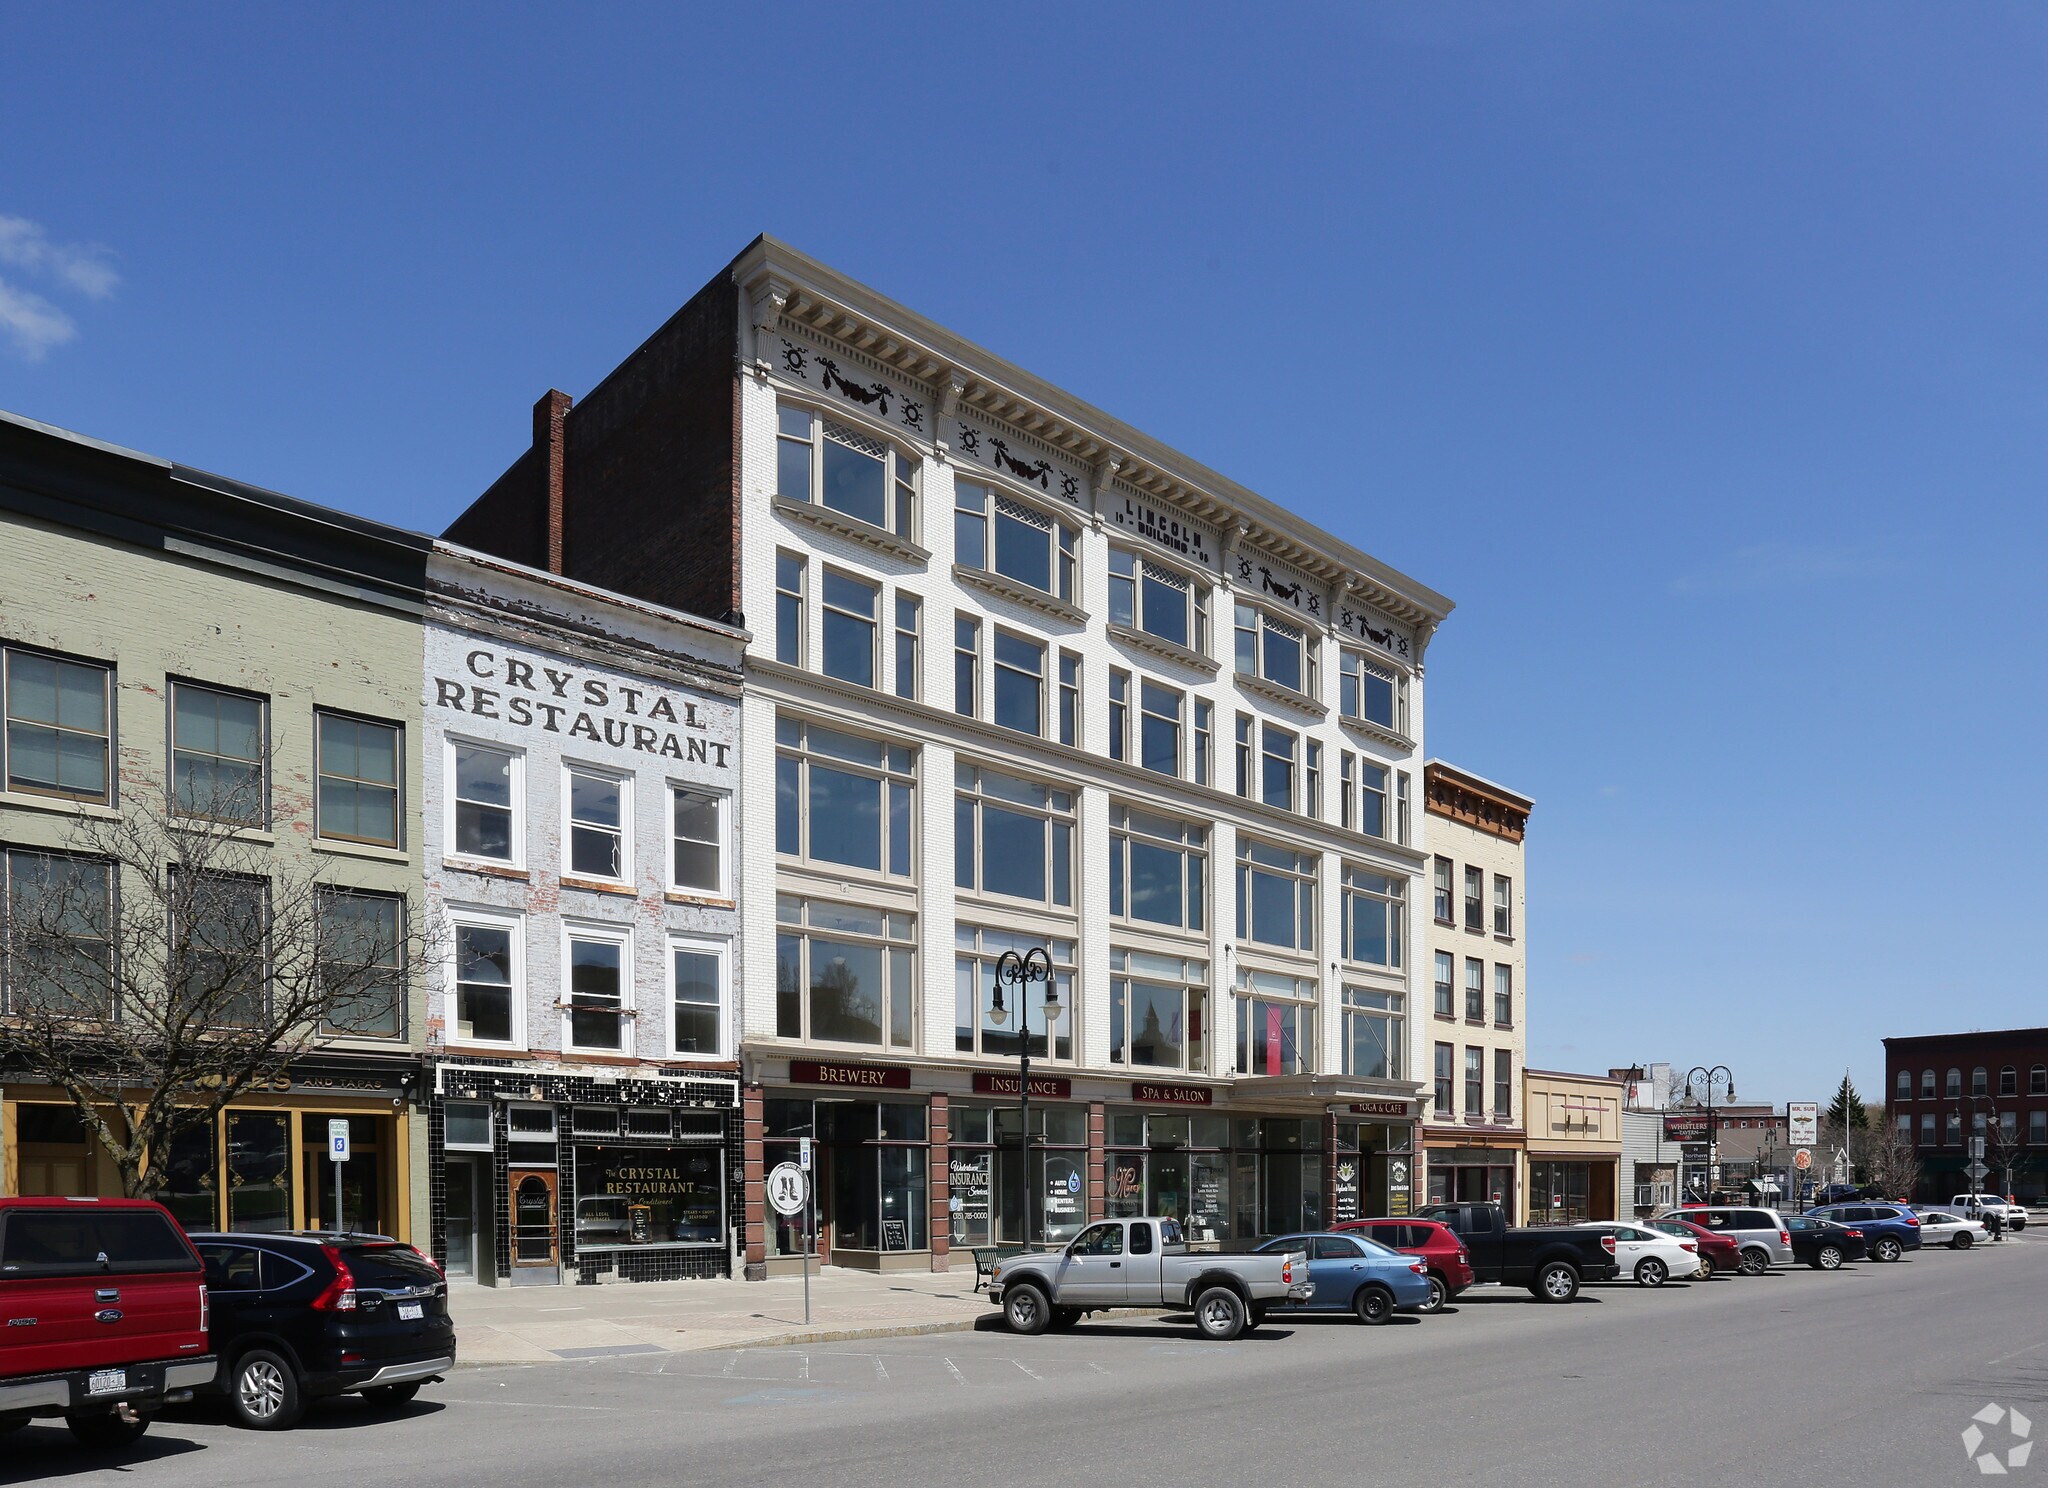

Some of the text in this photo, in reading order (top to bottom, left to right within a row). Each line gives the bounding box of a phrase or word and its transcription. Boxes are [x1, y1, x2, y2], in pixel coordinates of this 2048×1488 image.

[1126, 499, 1201, 549] LINCOLN
[1115, 511, 1124, 524] 19
[1138, 521, 1188, 554] BUILDING
[466, 650, 706, 730] CRYSTAL
[434, 677, 731, 768] RESTAURANT
[303, 1077, 333, 1087] AND
[340, 1078, 382, 1089] TAPAS
[991, 1077, 1057, 1095] INSUANCE
[1142, 1086, 1205, 1102] SPA & SALON
[619, 1167, 681, 1180] CRYSTAL
[949, 1172, 990, 1186] INSURANCE
[606, 1182, 695, 1195] RESTAURANT
[102, 1311, 119, 1320] Ford
